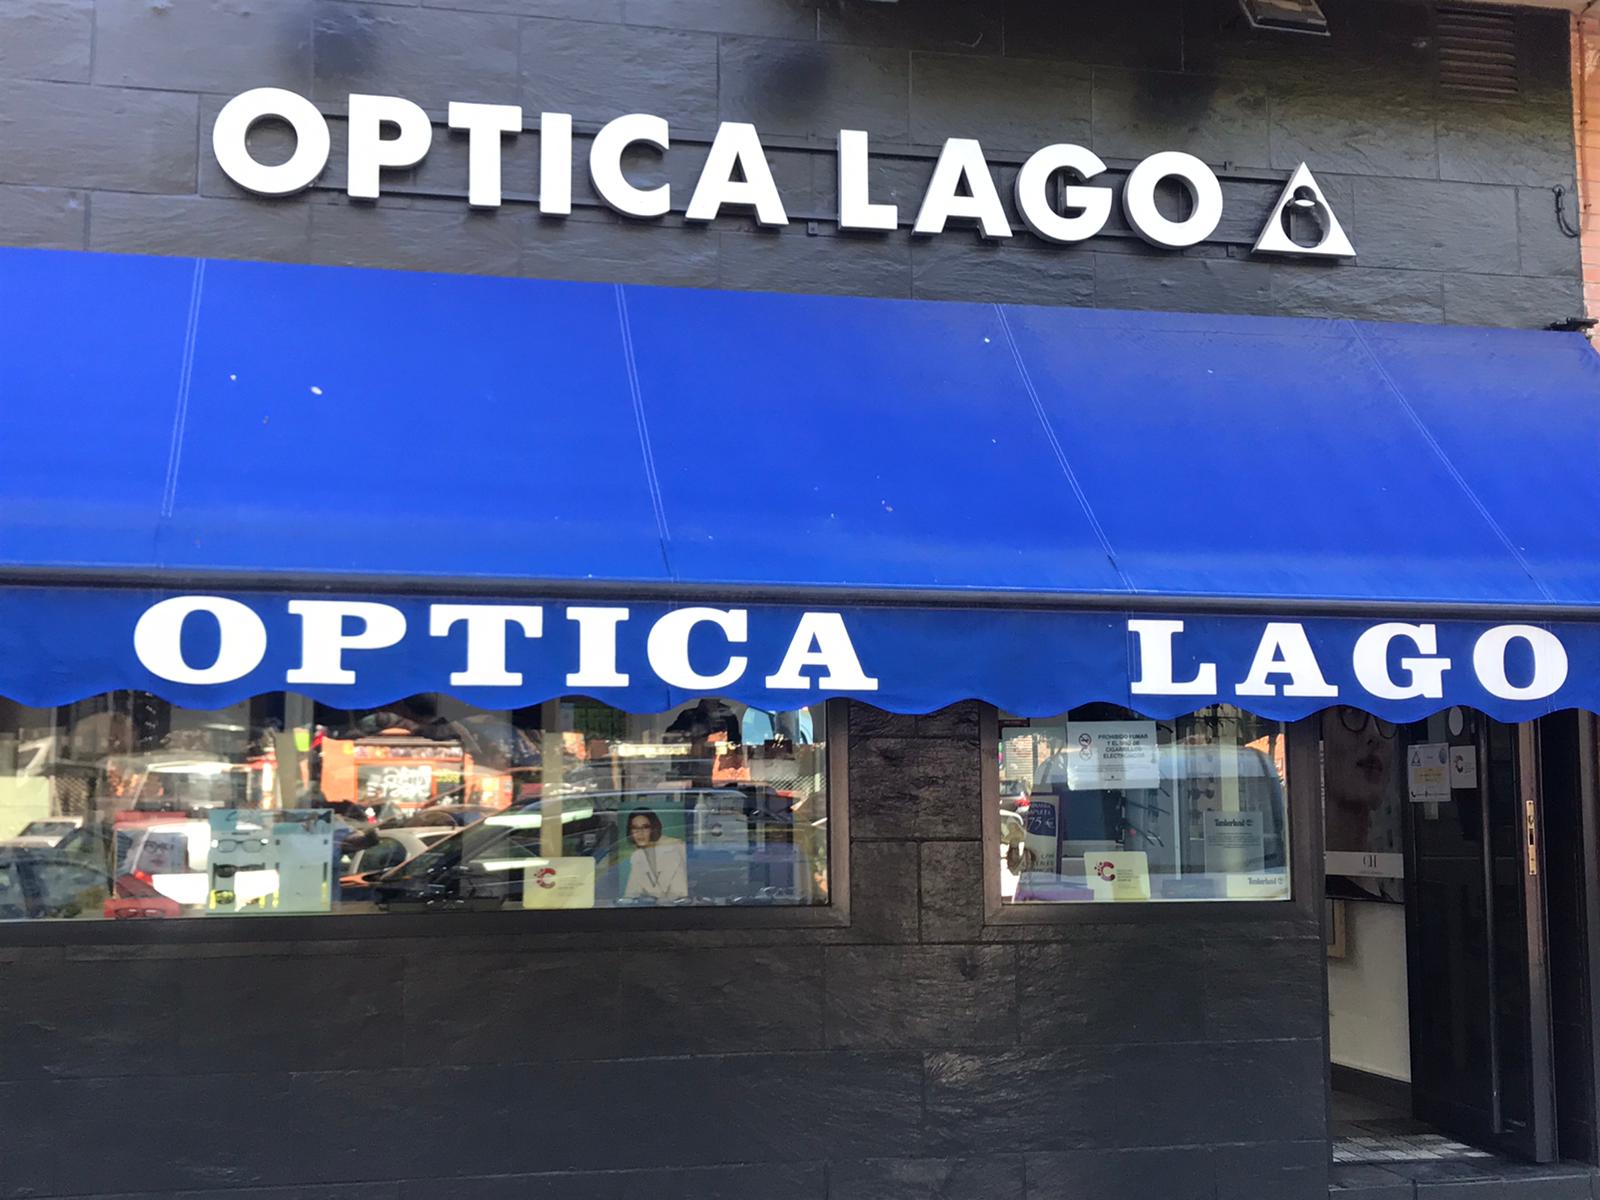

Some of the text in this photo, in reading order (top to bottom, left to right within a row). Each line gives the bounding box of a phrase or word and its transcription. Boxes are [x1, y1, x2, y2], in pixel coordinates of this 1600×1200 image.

[212, 87, 1224, 248] OPTICA LAGO
[133, 595, 1569, 701] OPTICA LAGO
